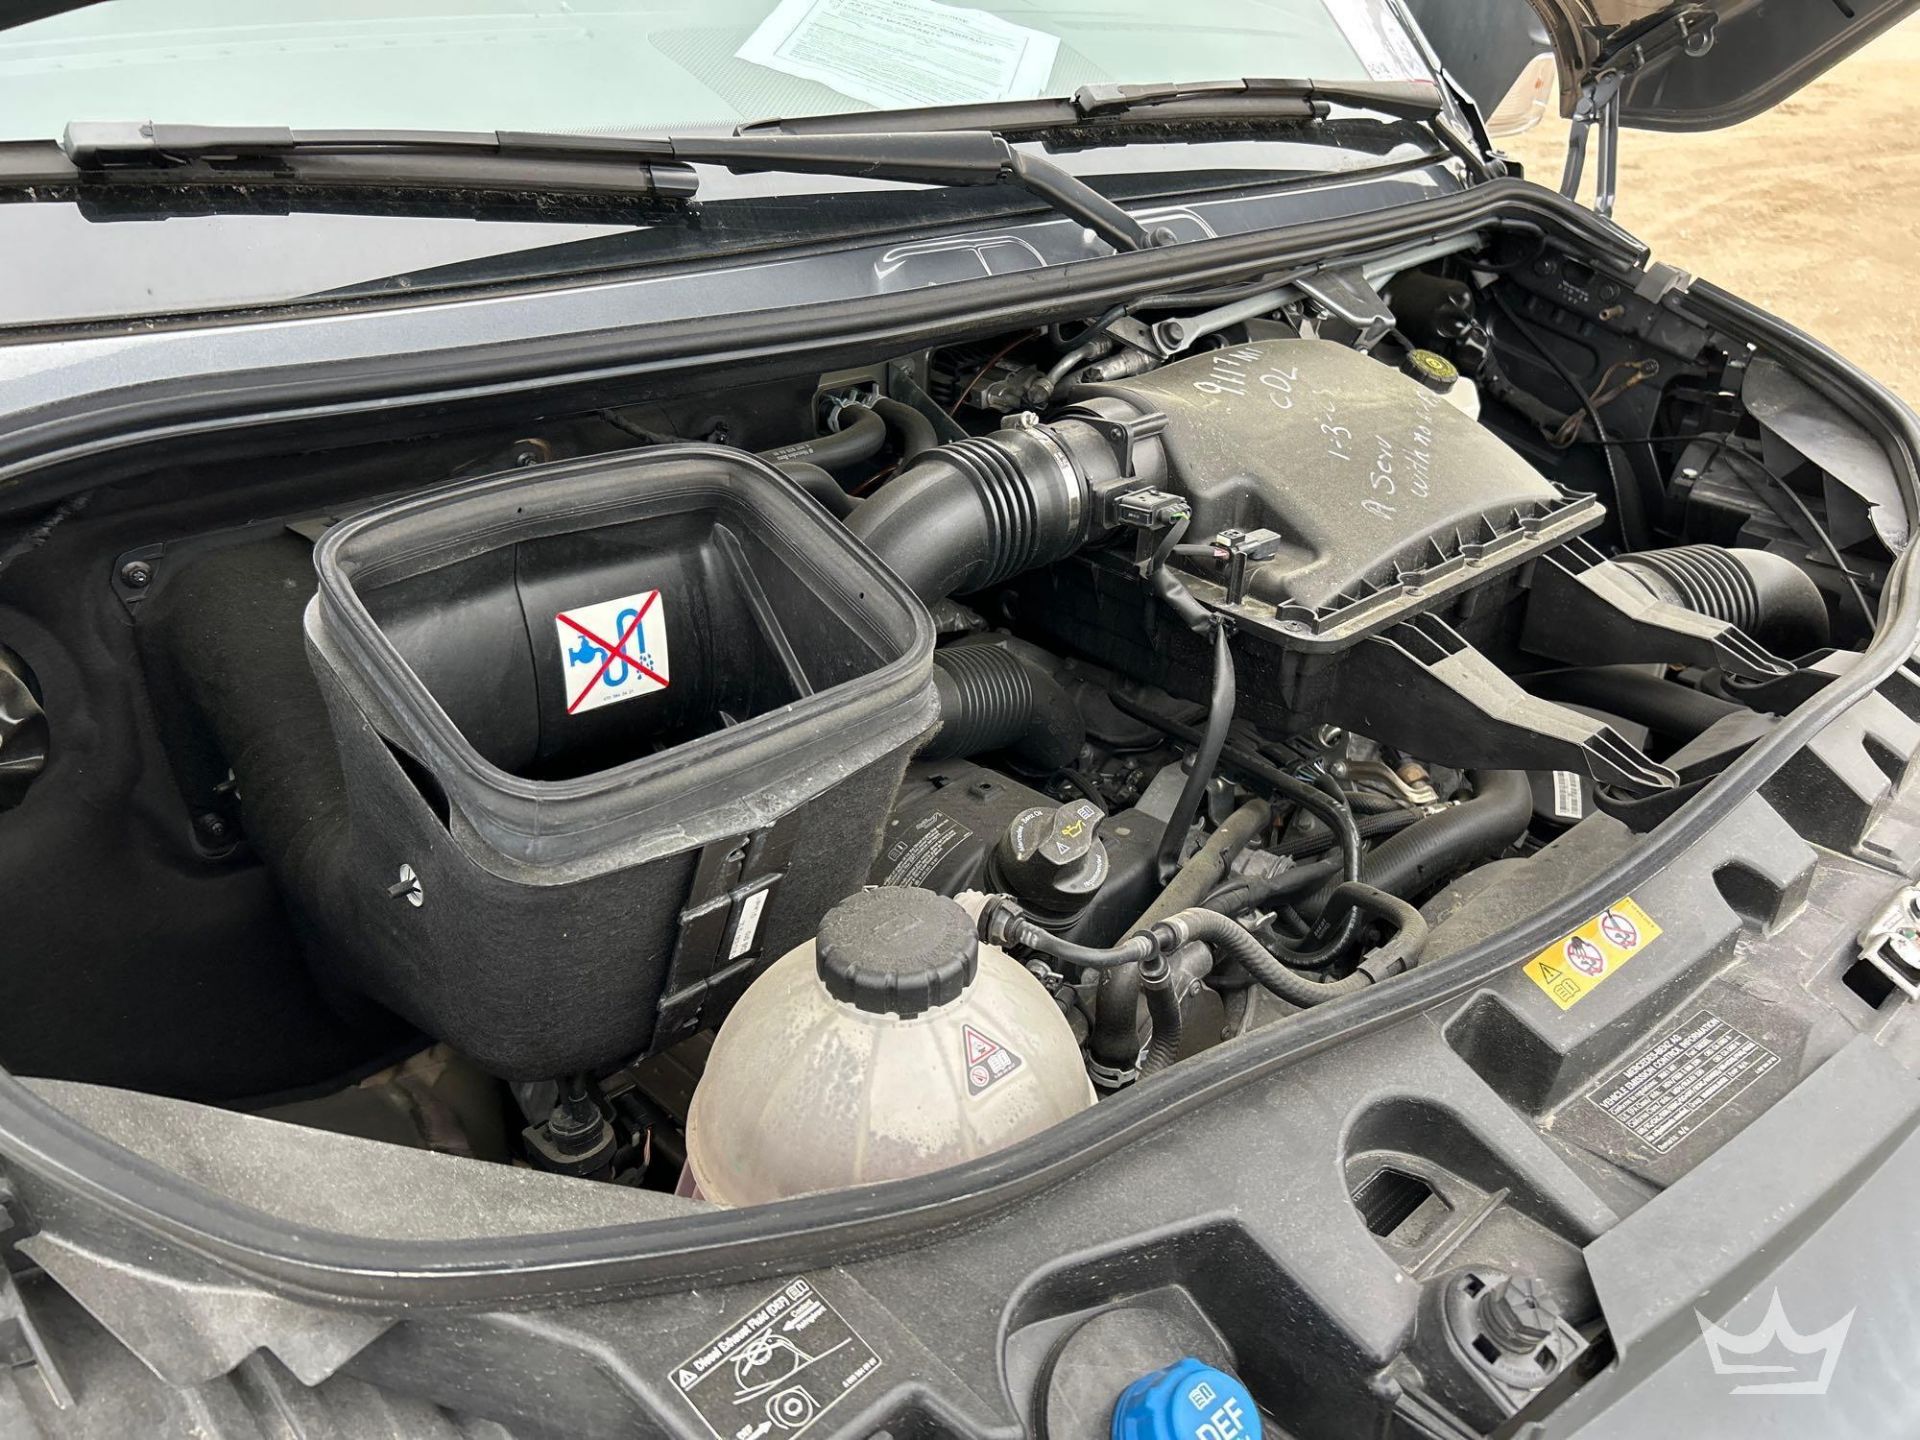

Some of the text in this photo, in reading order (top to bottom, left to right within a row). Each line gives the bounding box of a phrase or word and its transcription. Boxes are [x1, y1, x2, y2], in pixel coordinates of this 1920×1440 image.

[1259, 366, 1300, 409] CDL
[1599, 1086, 1628, 1107] VEHICLE
[1624, 1066, 1655, 1089] EMISSION
[1653, 1046, 1683, 1068] CONTROL
[1679, 1018, 1719, 1048] INFORMATION
[693, 1347, 721, 1370] Diesel
[718, 1325, 751, 1352] Exhaust
[747, 1310, 769, 1329] Fluid
